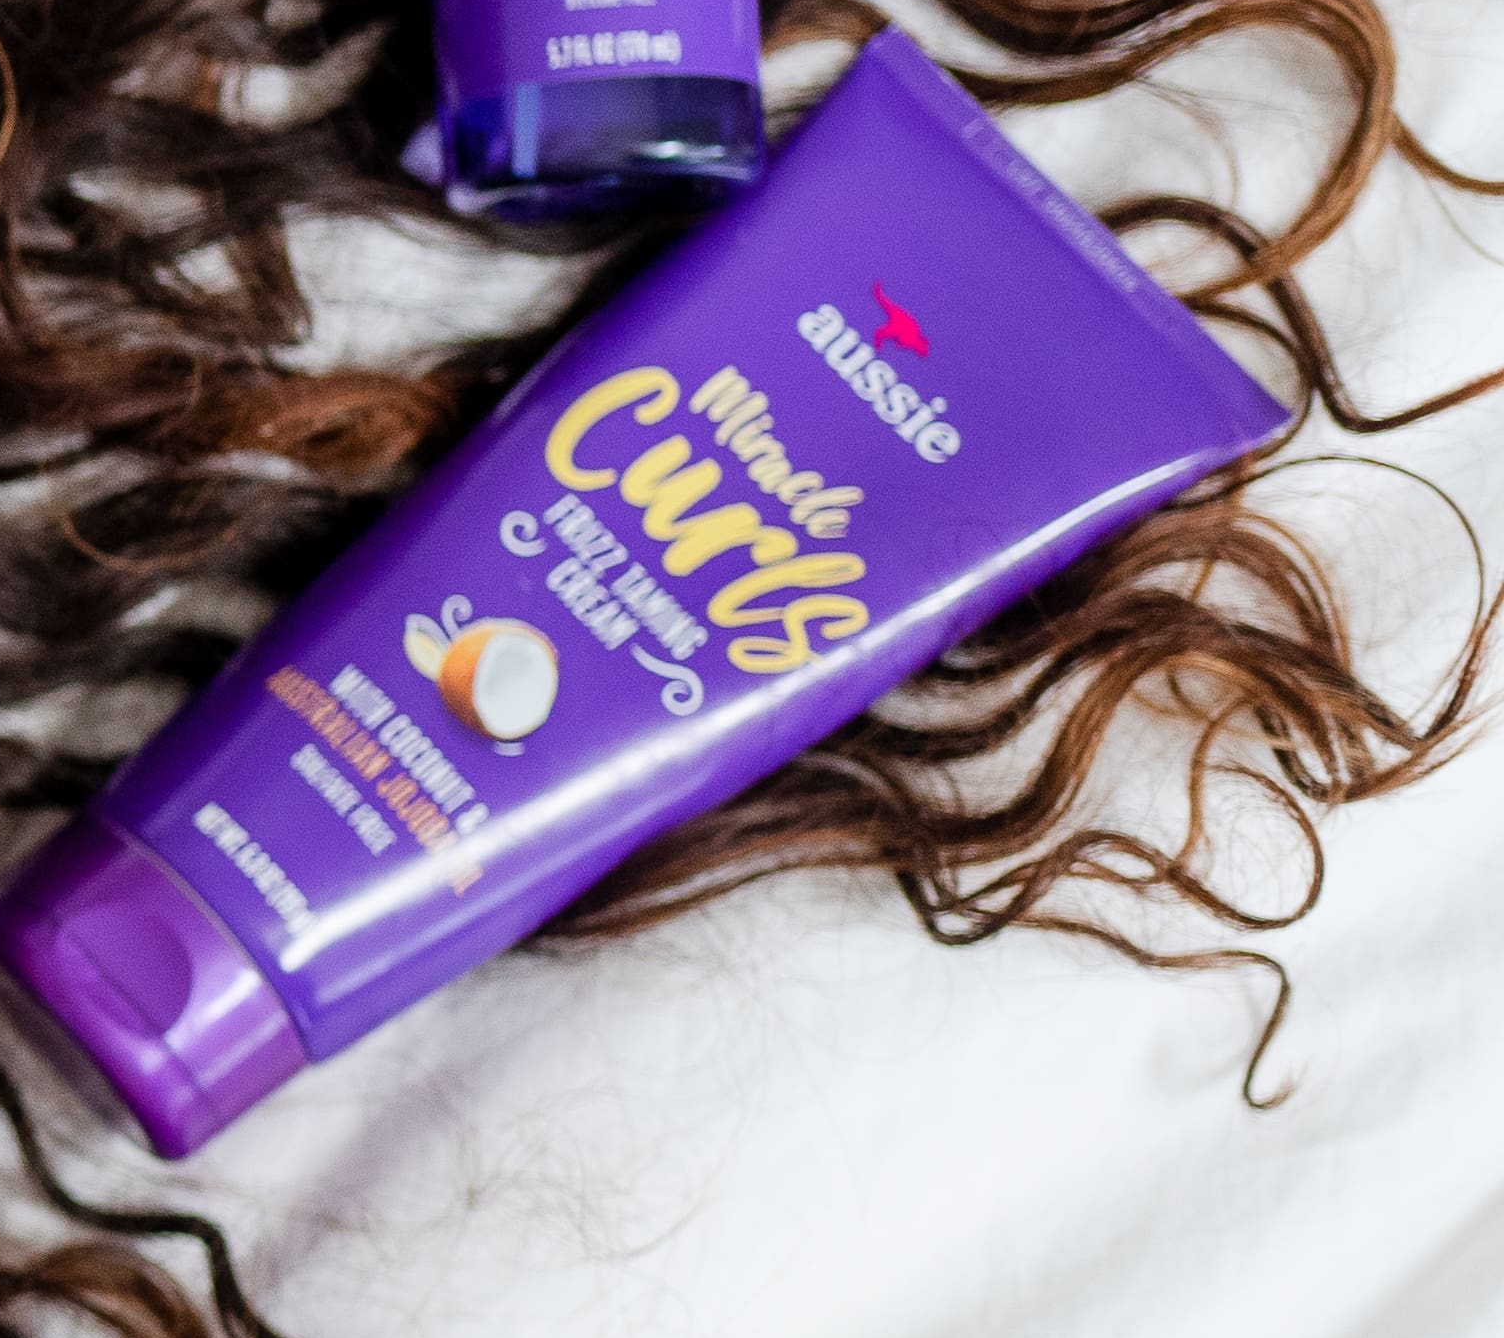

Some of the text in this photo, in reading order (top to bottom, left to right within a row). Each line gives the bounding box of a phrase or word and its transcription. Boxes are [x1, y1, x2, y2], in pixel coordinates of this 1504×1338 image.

[690, 365, 864, 539] Miracle
[796, 303, 961, 464] aussie
[542, 493, 709, 662] FRIZZ TAMING
[544, 365, 870, 674] Curls
[544, 556, 639, 651] CREAM
[265, 667, 392, 781] AUSTRALIAN
[328, 663, 395, 731] WITH
[377, 713, 475, 815] COCONUT
